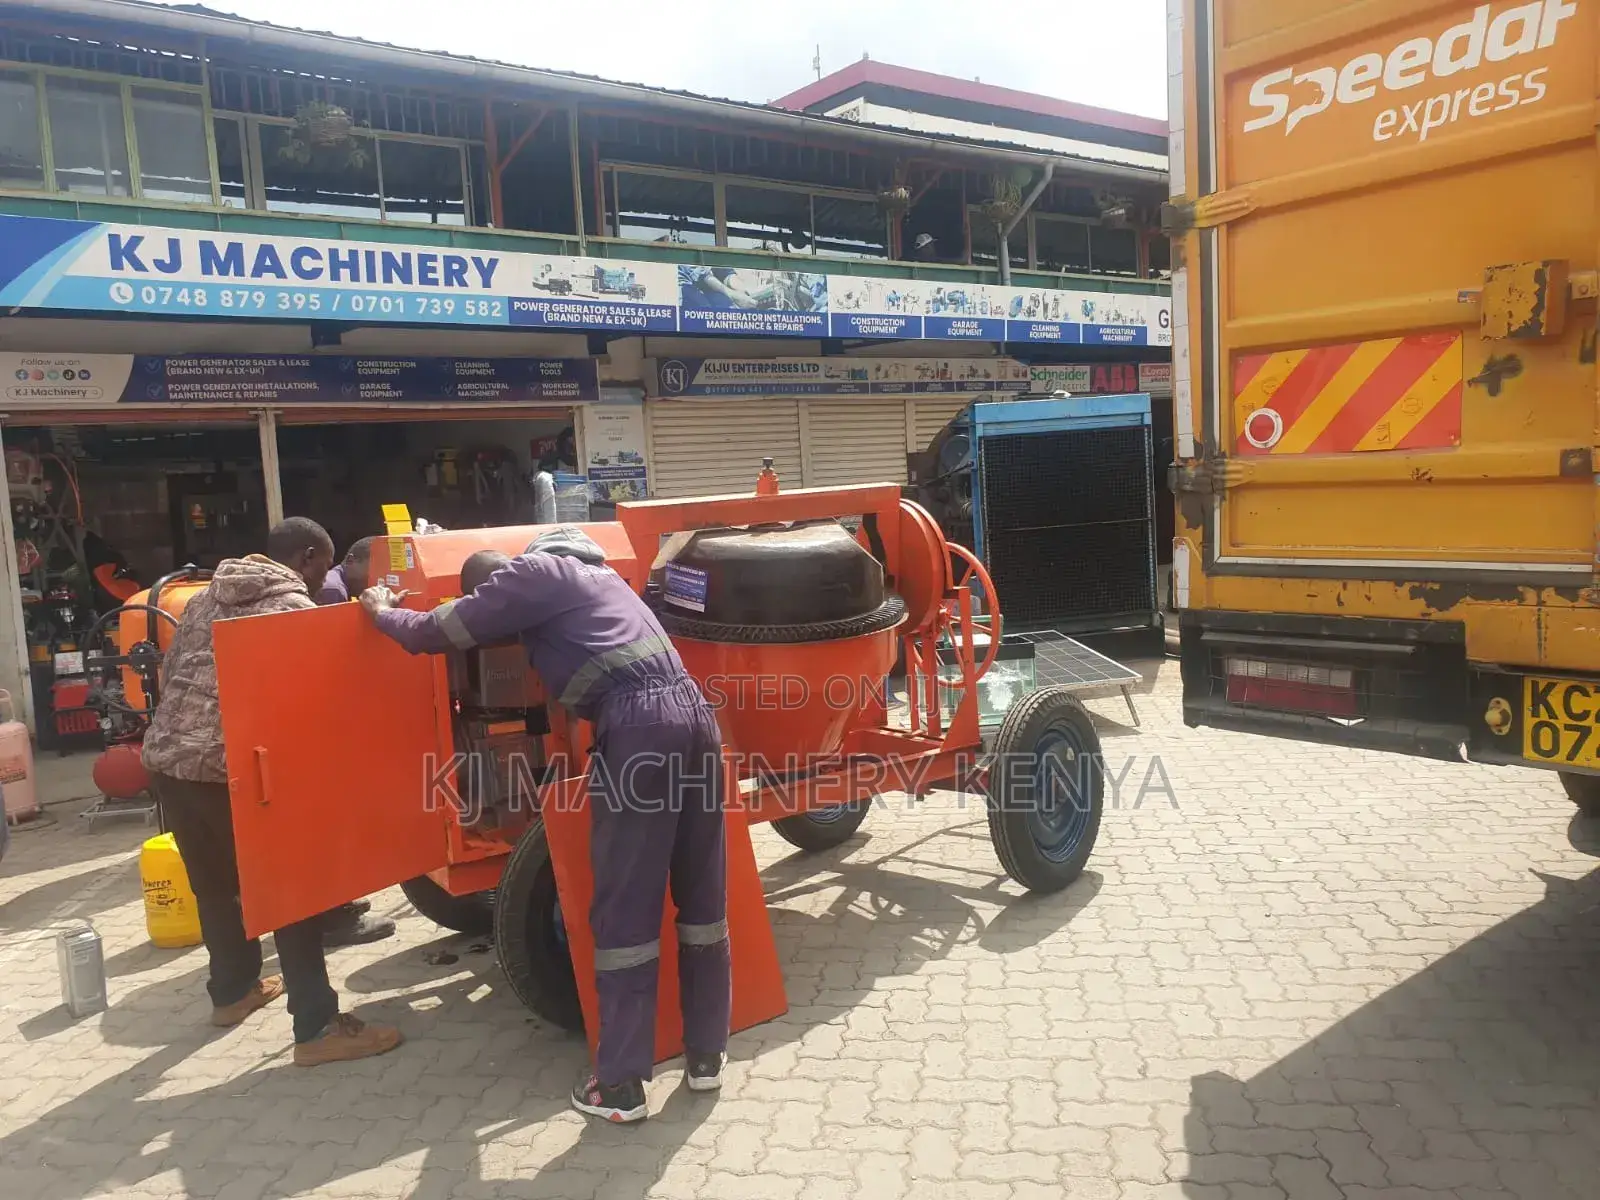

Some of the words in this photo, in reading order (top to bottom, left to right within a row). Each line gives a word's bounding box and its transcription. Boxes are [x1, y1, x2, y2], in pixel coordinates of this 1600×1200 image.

[1372, 67, 1549, 143] express
[107, 233, 182, 275] KJ
[199, 239, 500, 289] MACHINERY
[141, 286, 208, 307] 0748
[220, 290, 266, 310] 879
[277, 292, 321, 312] 395
[351, 295, 404, 314] 0701
[416, 297, 455, 315] 739
[465, 300, 502, 318] 582
[513, 301, 550, 312] POWER
[551, 303, 608, 315] GENERATOR
[609, 306, 636, 316] SALES
[637, 307, 645, 317] &
[646, 308, 672, 319] LEASE
[543, 312, 581, 324] (BRAND
[582, 314, 604, 324] NEW
[605, 315, 613, 325] &
[614, 315, 647, 328] EX-UK)
[684, 310, 707, 320] POWER
[708, 312, 763, 322] GENERATOR
[763, 314, 823, 326] INSTALLATIONS,
[850, 317, 905, 328] CONSTRUCTION
[706, 320, 765, 331] MAINTENANCE
[773, 322, 804, 332] REPAIRS
[858, 325, 898, 335] EQUIPMENT
[952, 320, 979, 330] GARAGE
[1031, 324, 1060, 333] CLEANING
[947, 327, 983, 337] EQUIPMENT
[1029, 331, 1062, 340] EQUIPMENT
[1099, 327, 1137, 336] AGRICULTURAL
[1102, 334, 1133, 342] MACHINERY
[165, 359, 198, 367] POWER
[200, 359, 250, 367] GENERATOR
[252, 359, 278, 367] SALES
[287, 359, 311, 367] LEASE
[356, 360, 417, 369] CONSTRUCTION
[704, 362, 731, 374] KIJU
[731, 362, 799, 374] ENTERPRISES
[802, 363, 820, 374] LTD
[166, 366, 201, 376] (BRAND
[204, 367, 224, 375] NEW
[358, 368, 401, 376] EQUIPMENT
[455, 368, 496, 376] EQUIPMENT
[1030, 367, 1087, 381] Schneider
[1092, 364, 1137, 392] ABB
[168, 383, 200, 391] POWER
[202, 383, 254, 391] GENERATOR
[360, 383, 392, 391] GARAGE
[457, 383, 510, 391] AGRICULTURAL
[31, 387, 88, 398] Machinery
[169, 391, 234, 400] MAINTENANCE
[243, 391, 278, 399] REPAIRS
[360, 390, 403, 399] EQUIPMENT
[458, 390, 501, 398] MACHINERY
[1531, 680, 1600, 723] KC
[1530, 720, 1600, 762] 07
